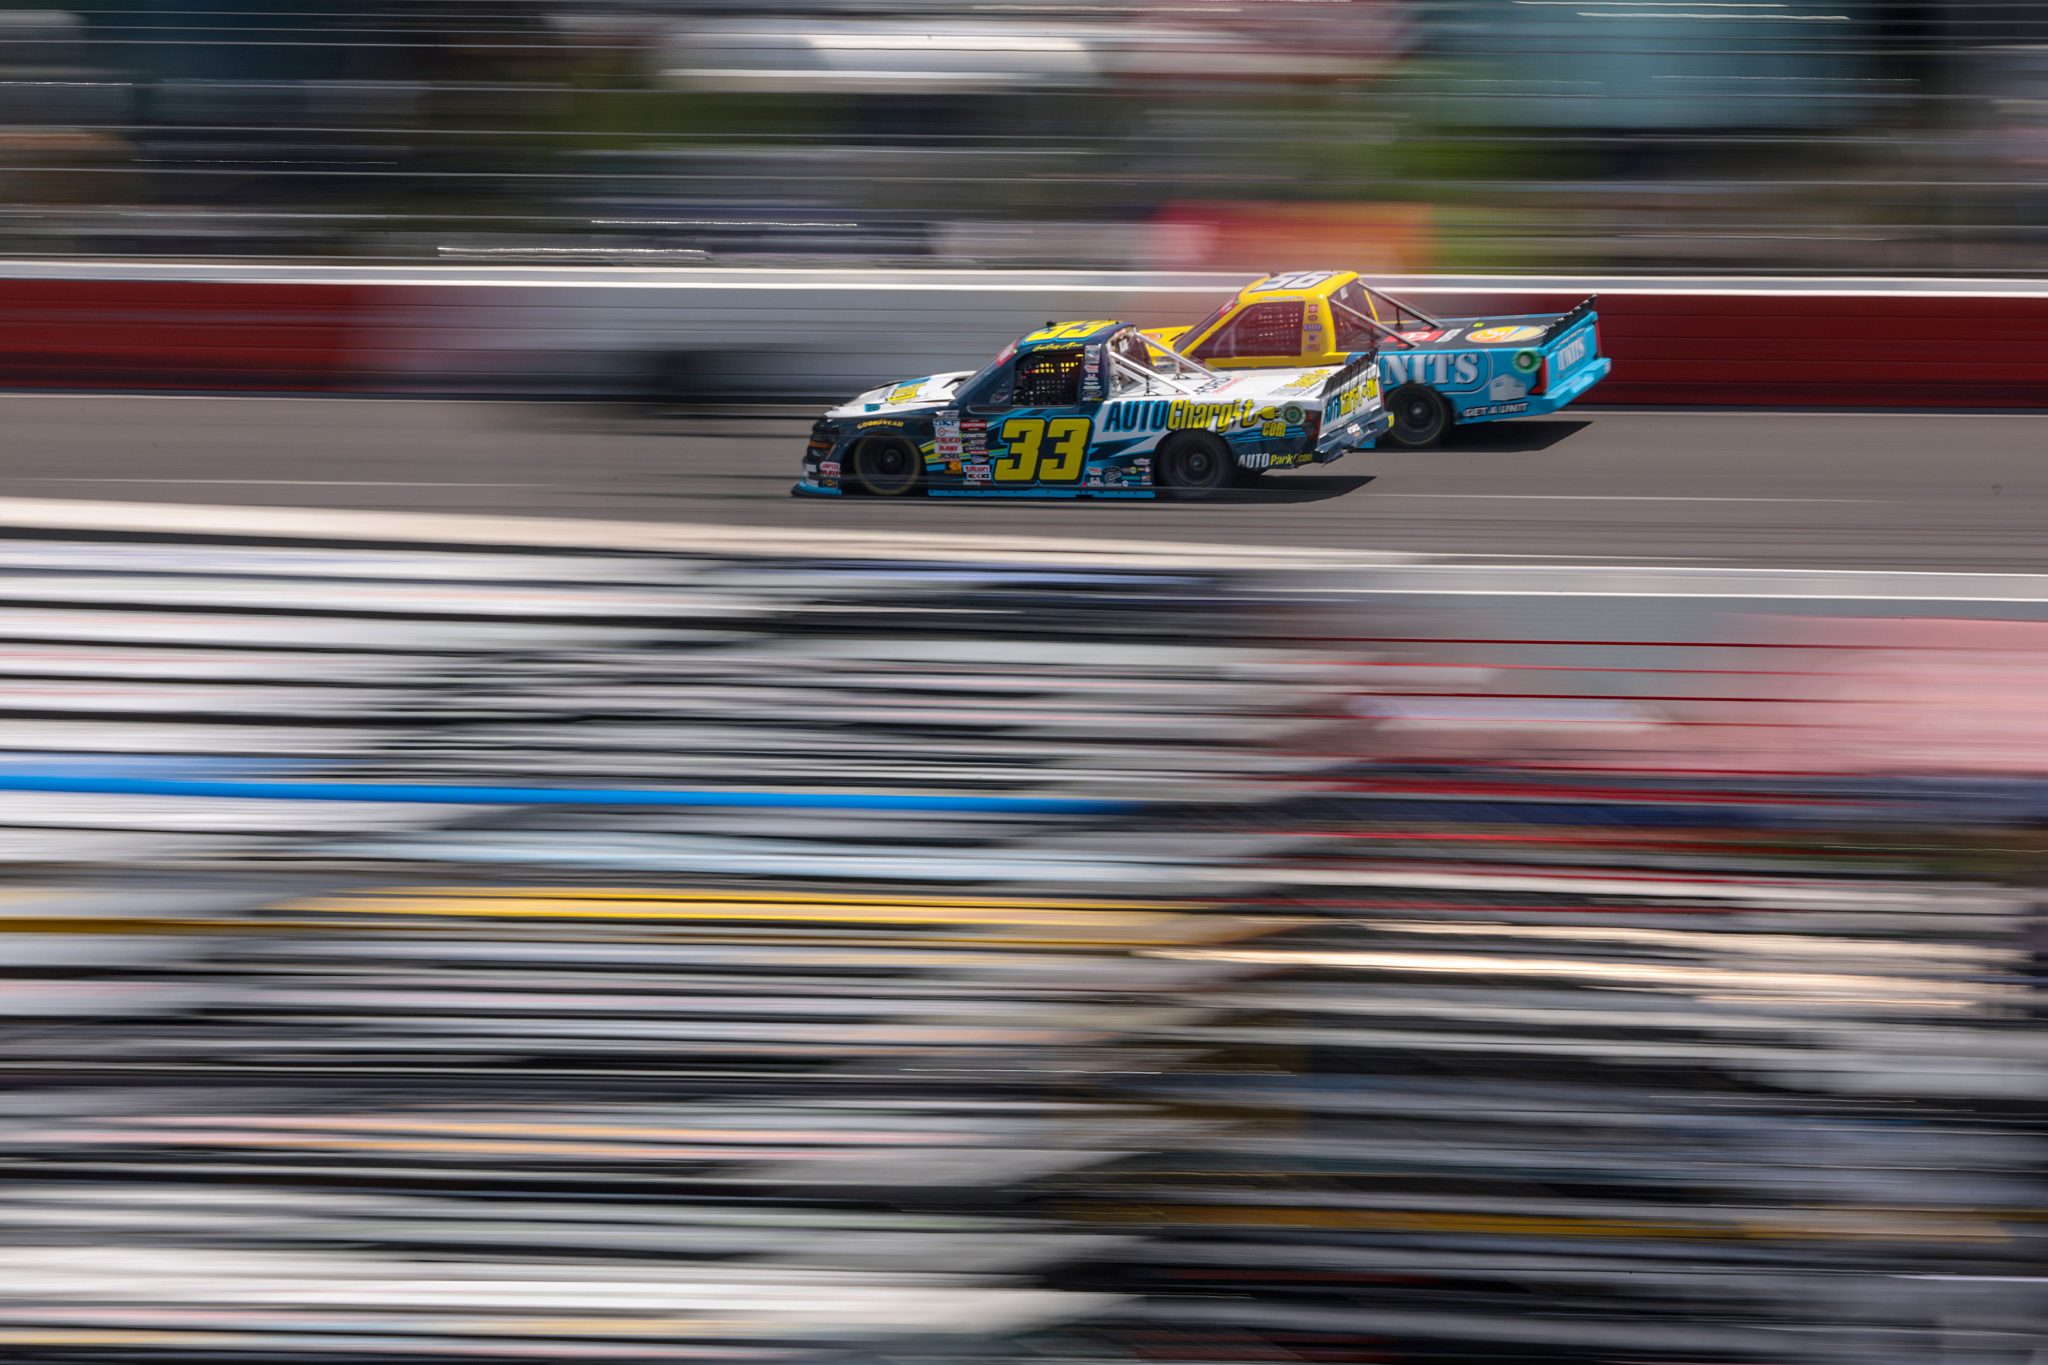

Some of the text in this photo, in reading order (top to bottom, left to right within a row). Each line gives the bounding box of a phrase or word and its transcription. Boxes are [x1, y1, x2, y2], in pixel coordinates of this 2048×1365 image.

[1024, 320, 1119, 341] 33
[1380, 352, 1479, 385] NITS
[1463, 402, 1529, 417] GET A UNIT
[857, 420, 904, 430] GOODYEAR
[994, 418, 1092, 481] 33
